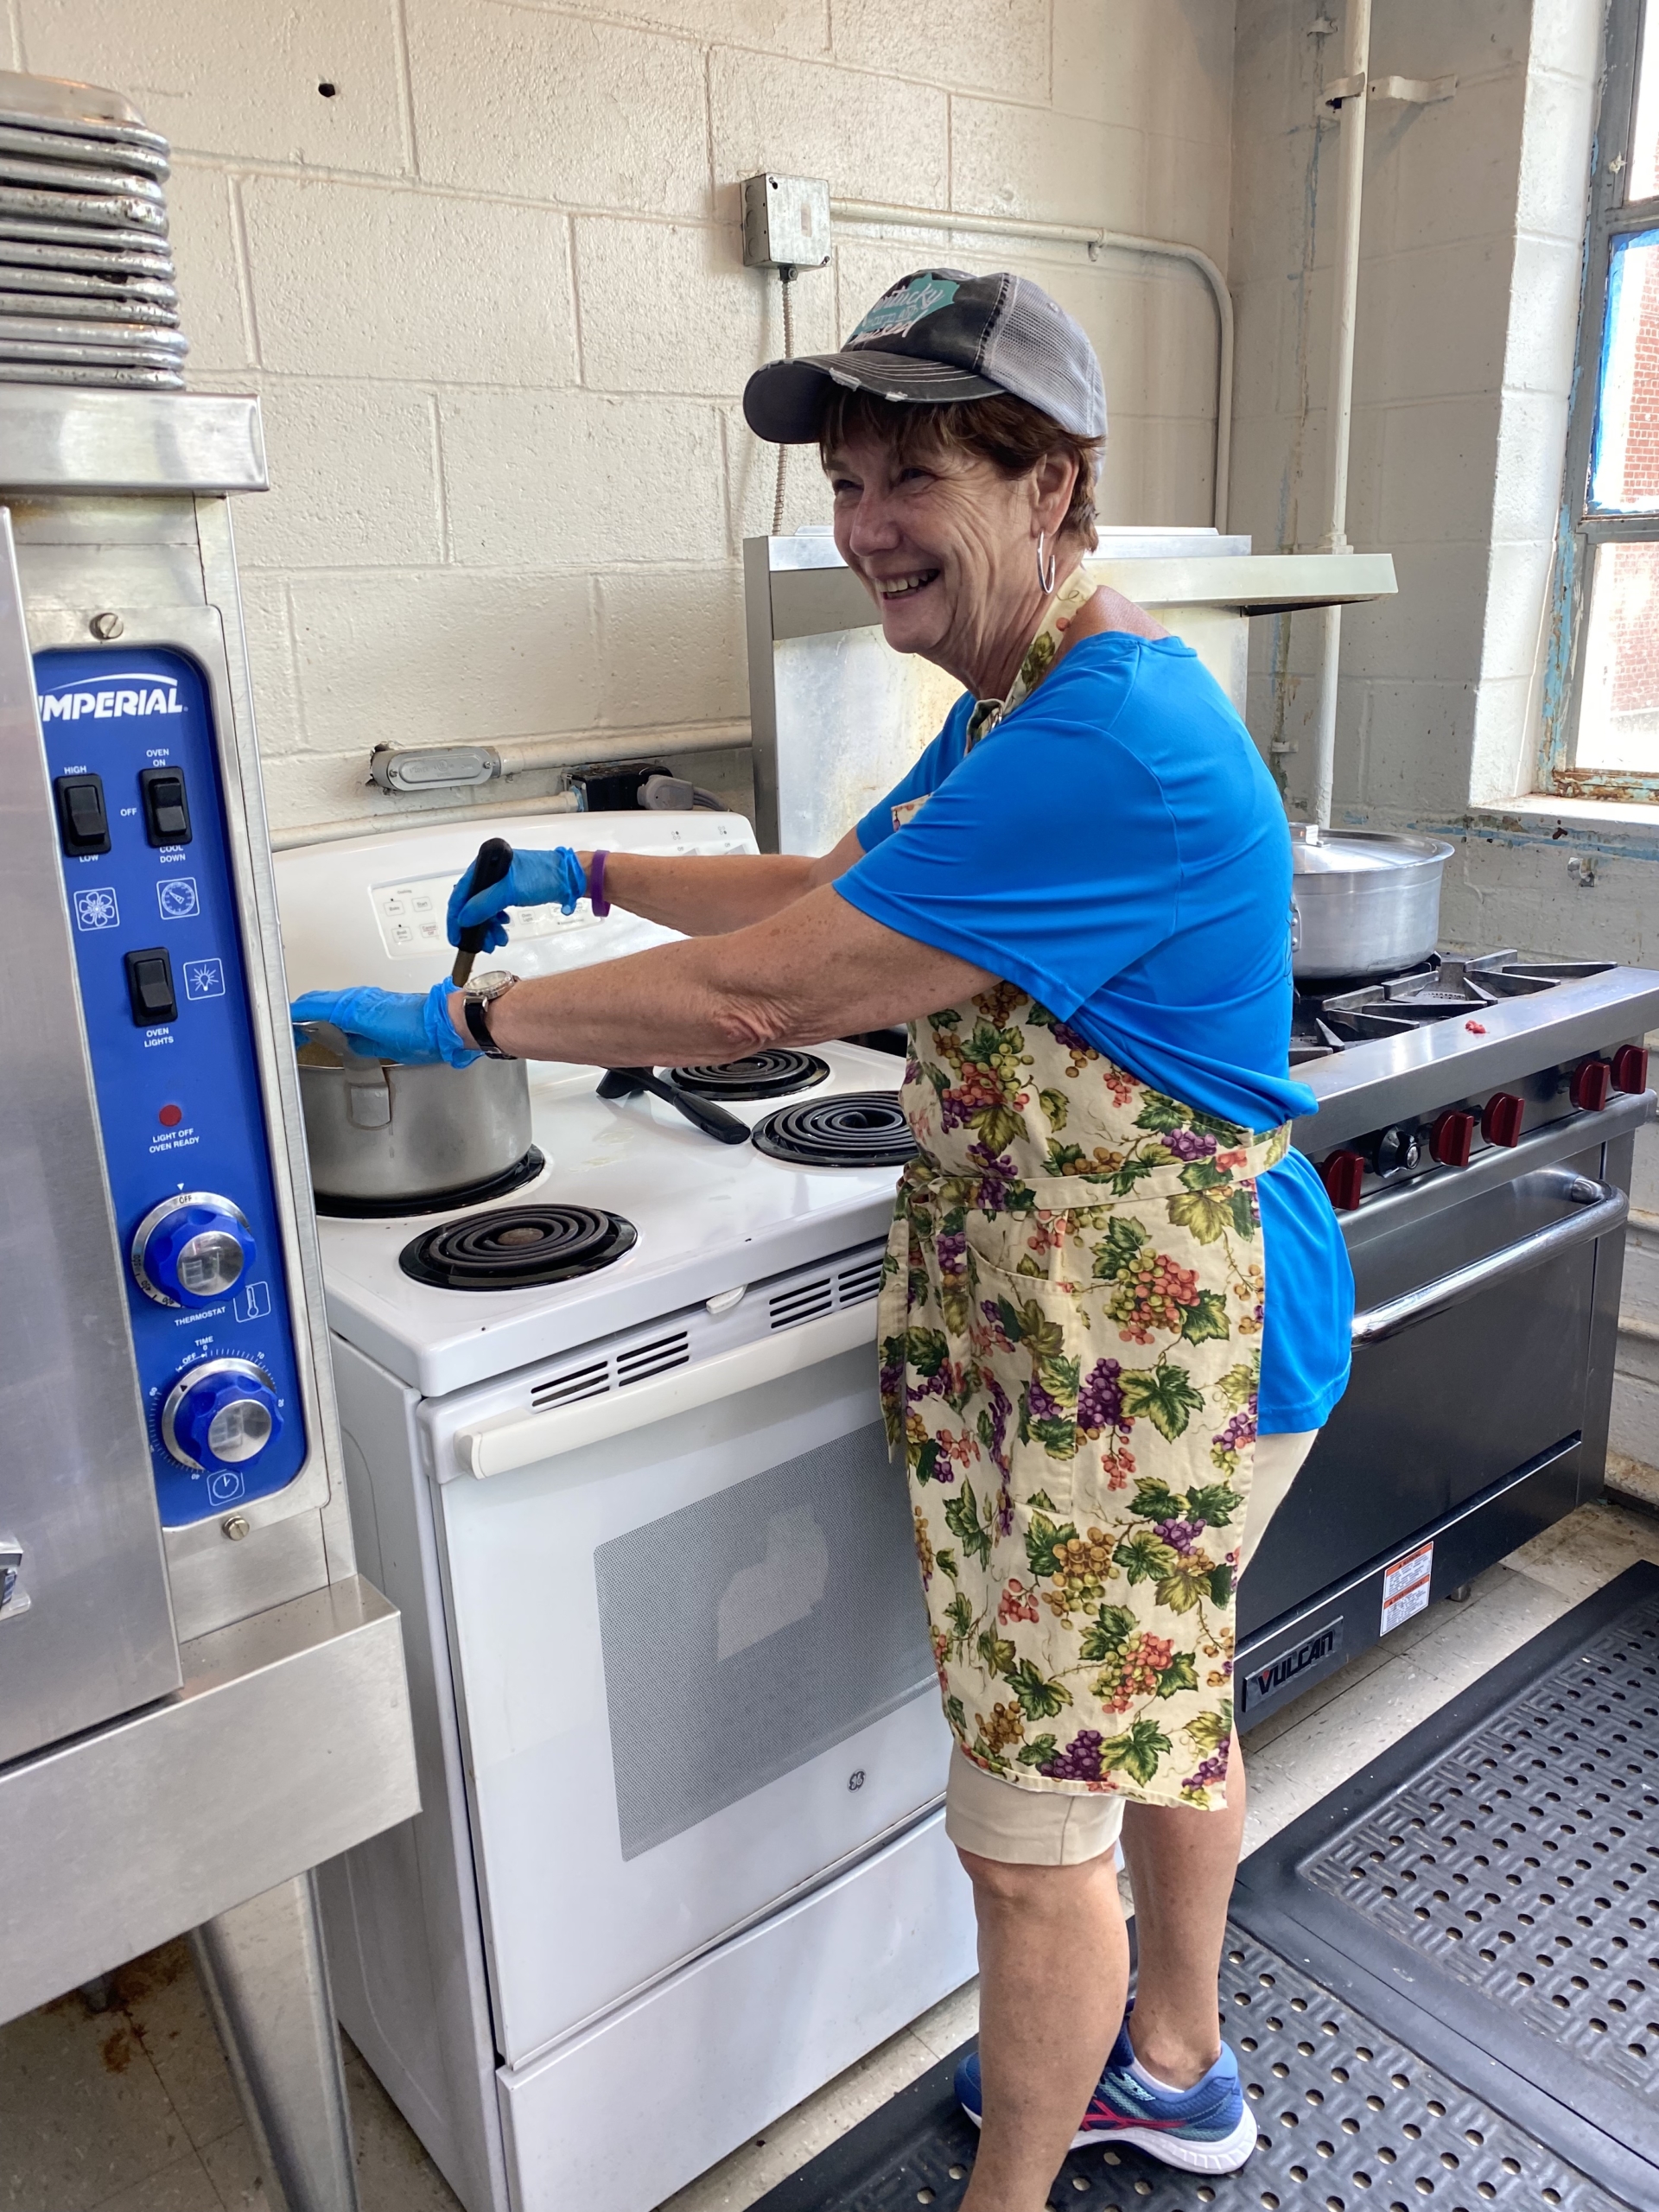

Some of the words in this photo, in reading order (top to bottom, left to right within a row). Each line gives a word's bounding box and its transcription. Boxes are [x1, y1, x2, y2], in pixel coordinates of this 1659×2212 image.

[146, 748, 169, 757] OVEN
[64, 766, 87, 774] HIGH
[120, 808, 137, 817] OFF
[79, 855, 99, 863] LOW
[160, 854, 187, 863] DOWN
[146, 1027, 169, 1038] OVEN
[143, 1035, 175, 1048] LIGHTS
[152, 1131, 176, 1143] LIGHT
[178, 1128, 194, 1138] OFF
[149, 1142, 172, 1154] OVEN
[173, 1135, 200, 1148] READY
[179, 1194, 193, 1204] OFF
[174, 1306, 226, 1326] THERMOSTAT
[194, 1335, 214, 1347] TIME
[181, 1352, 197, 1364] OFF
[257, 1351, 265, 1360] 10
[1257, 1630, 1333, 1695] VULCAN
